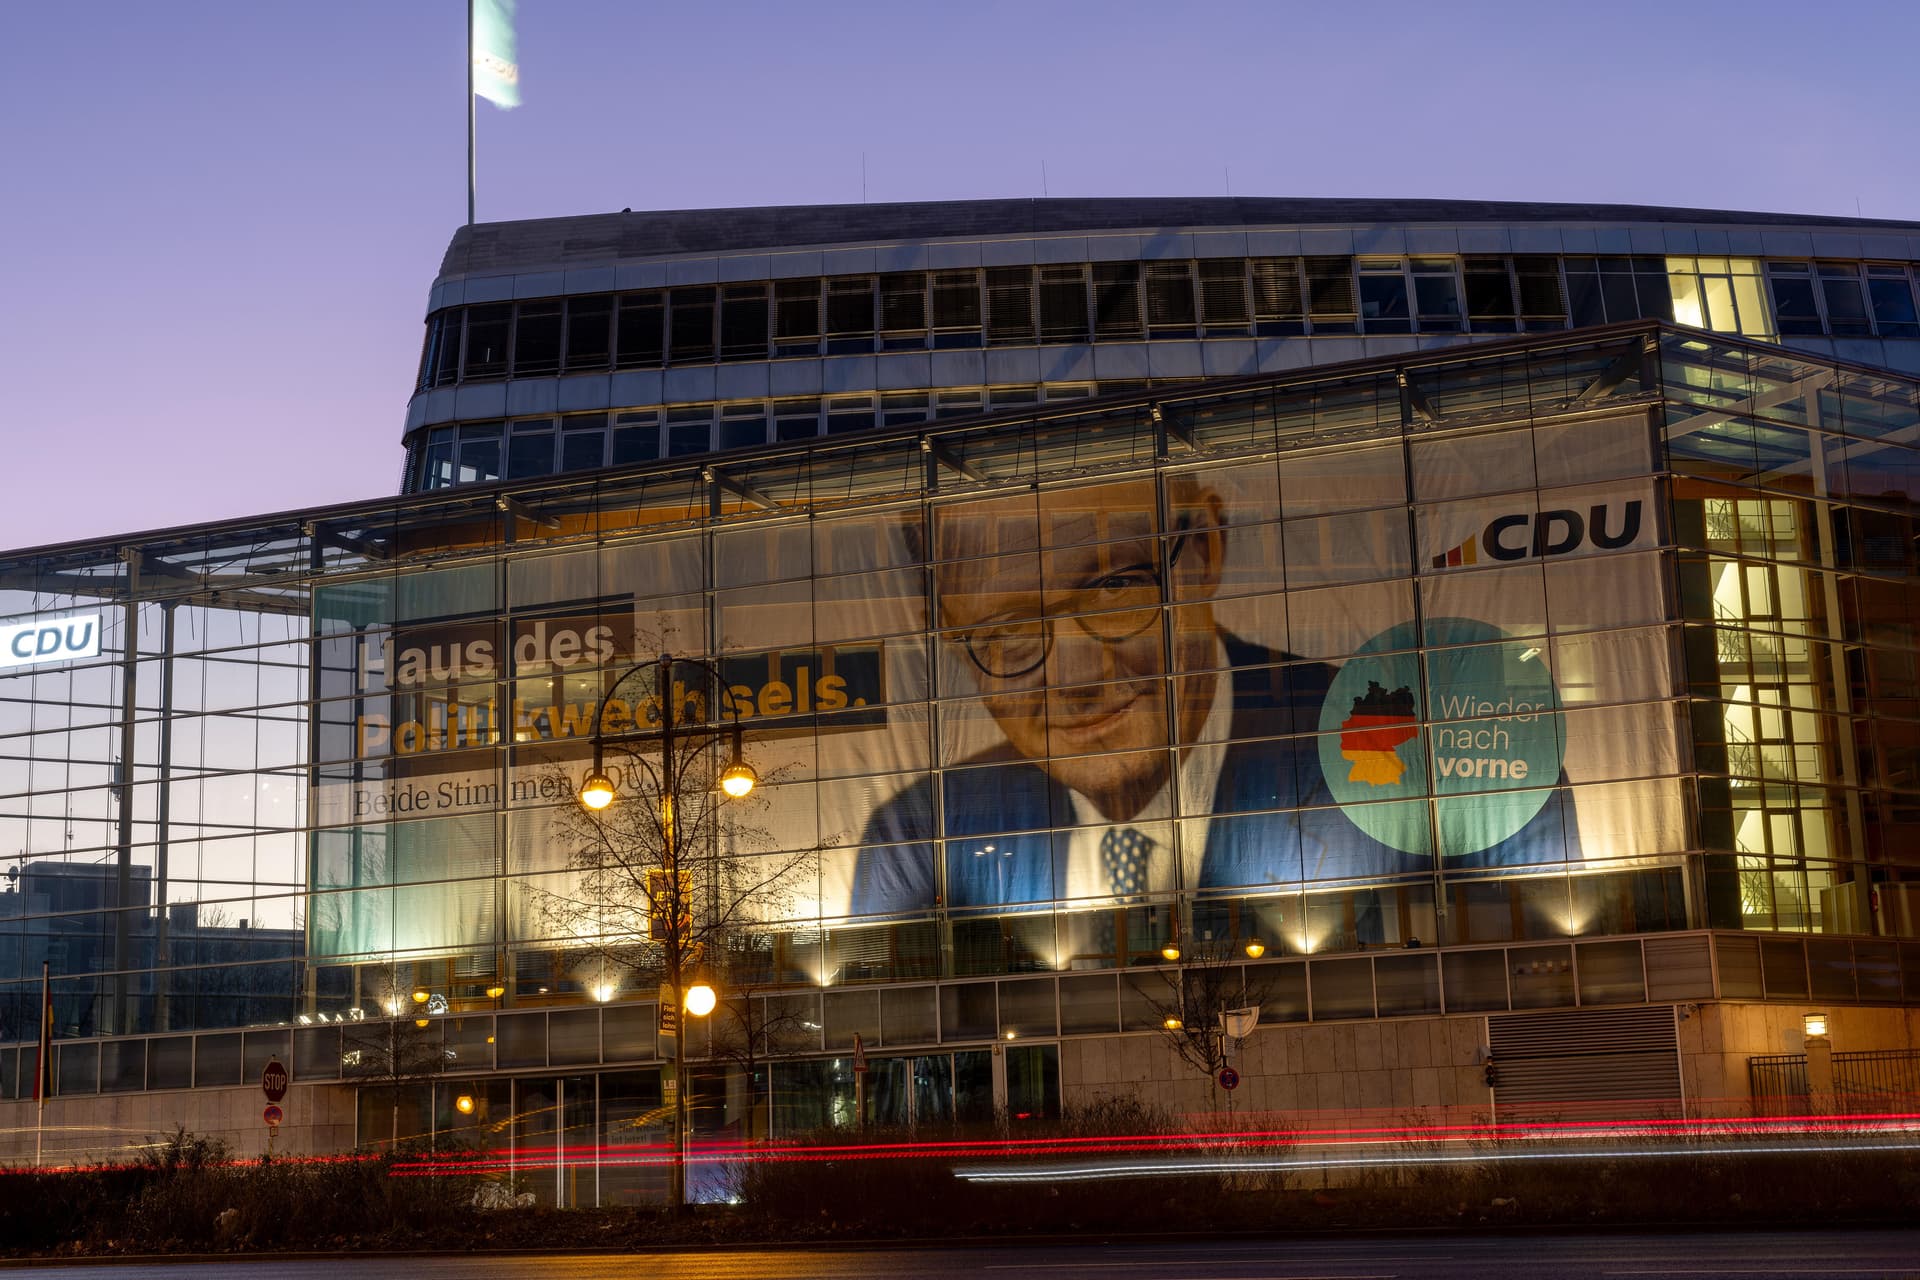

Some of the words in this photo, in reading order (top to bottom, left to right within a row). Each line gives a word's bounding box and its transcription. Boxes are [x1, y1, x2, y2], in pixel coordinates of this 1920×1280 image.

[1481, 499, 1643, 562] CDU
[11, 621, 94, 659] CDU
[358, 638, 495, 691] Haus
[513, 621, 615, 670] des
[1440, 695, 1545, 722] Wieder
[1439, 724, 1510, 751] nach
[1437, 756, 1529, 780] vorne
[353, 783, 430, 817] Beide
[437, 773, 574, 809] Stimmen
[264, 1073, 286, 1091] STOP
